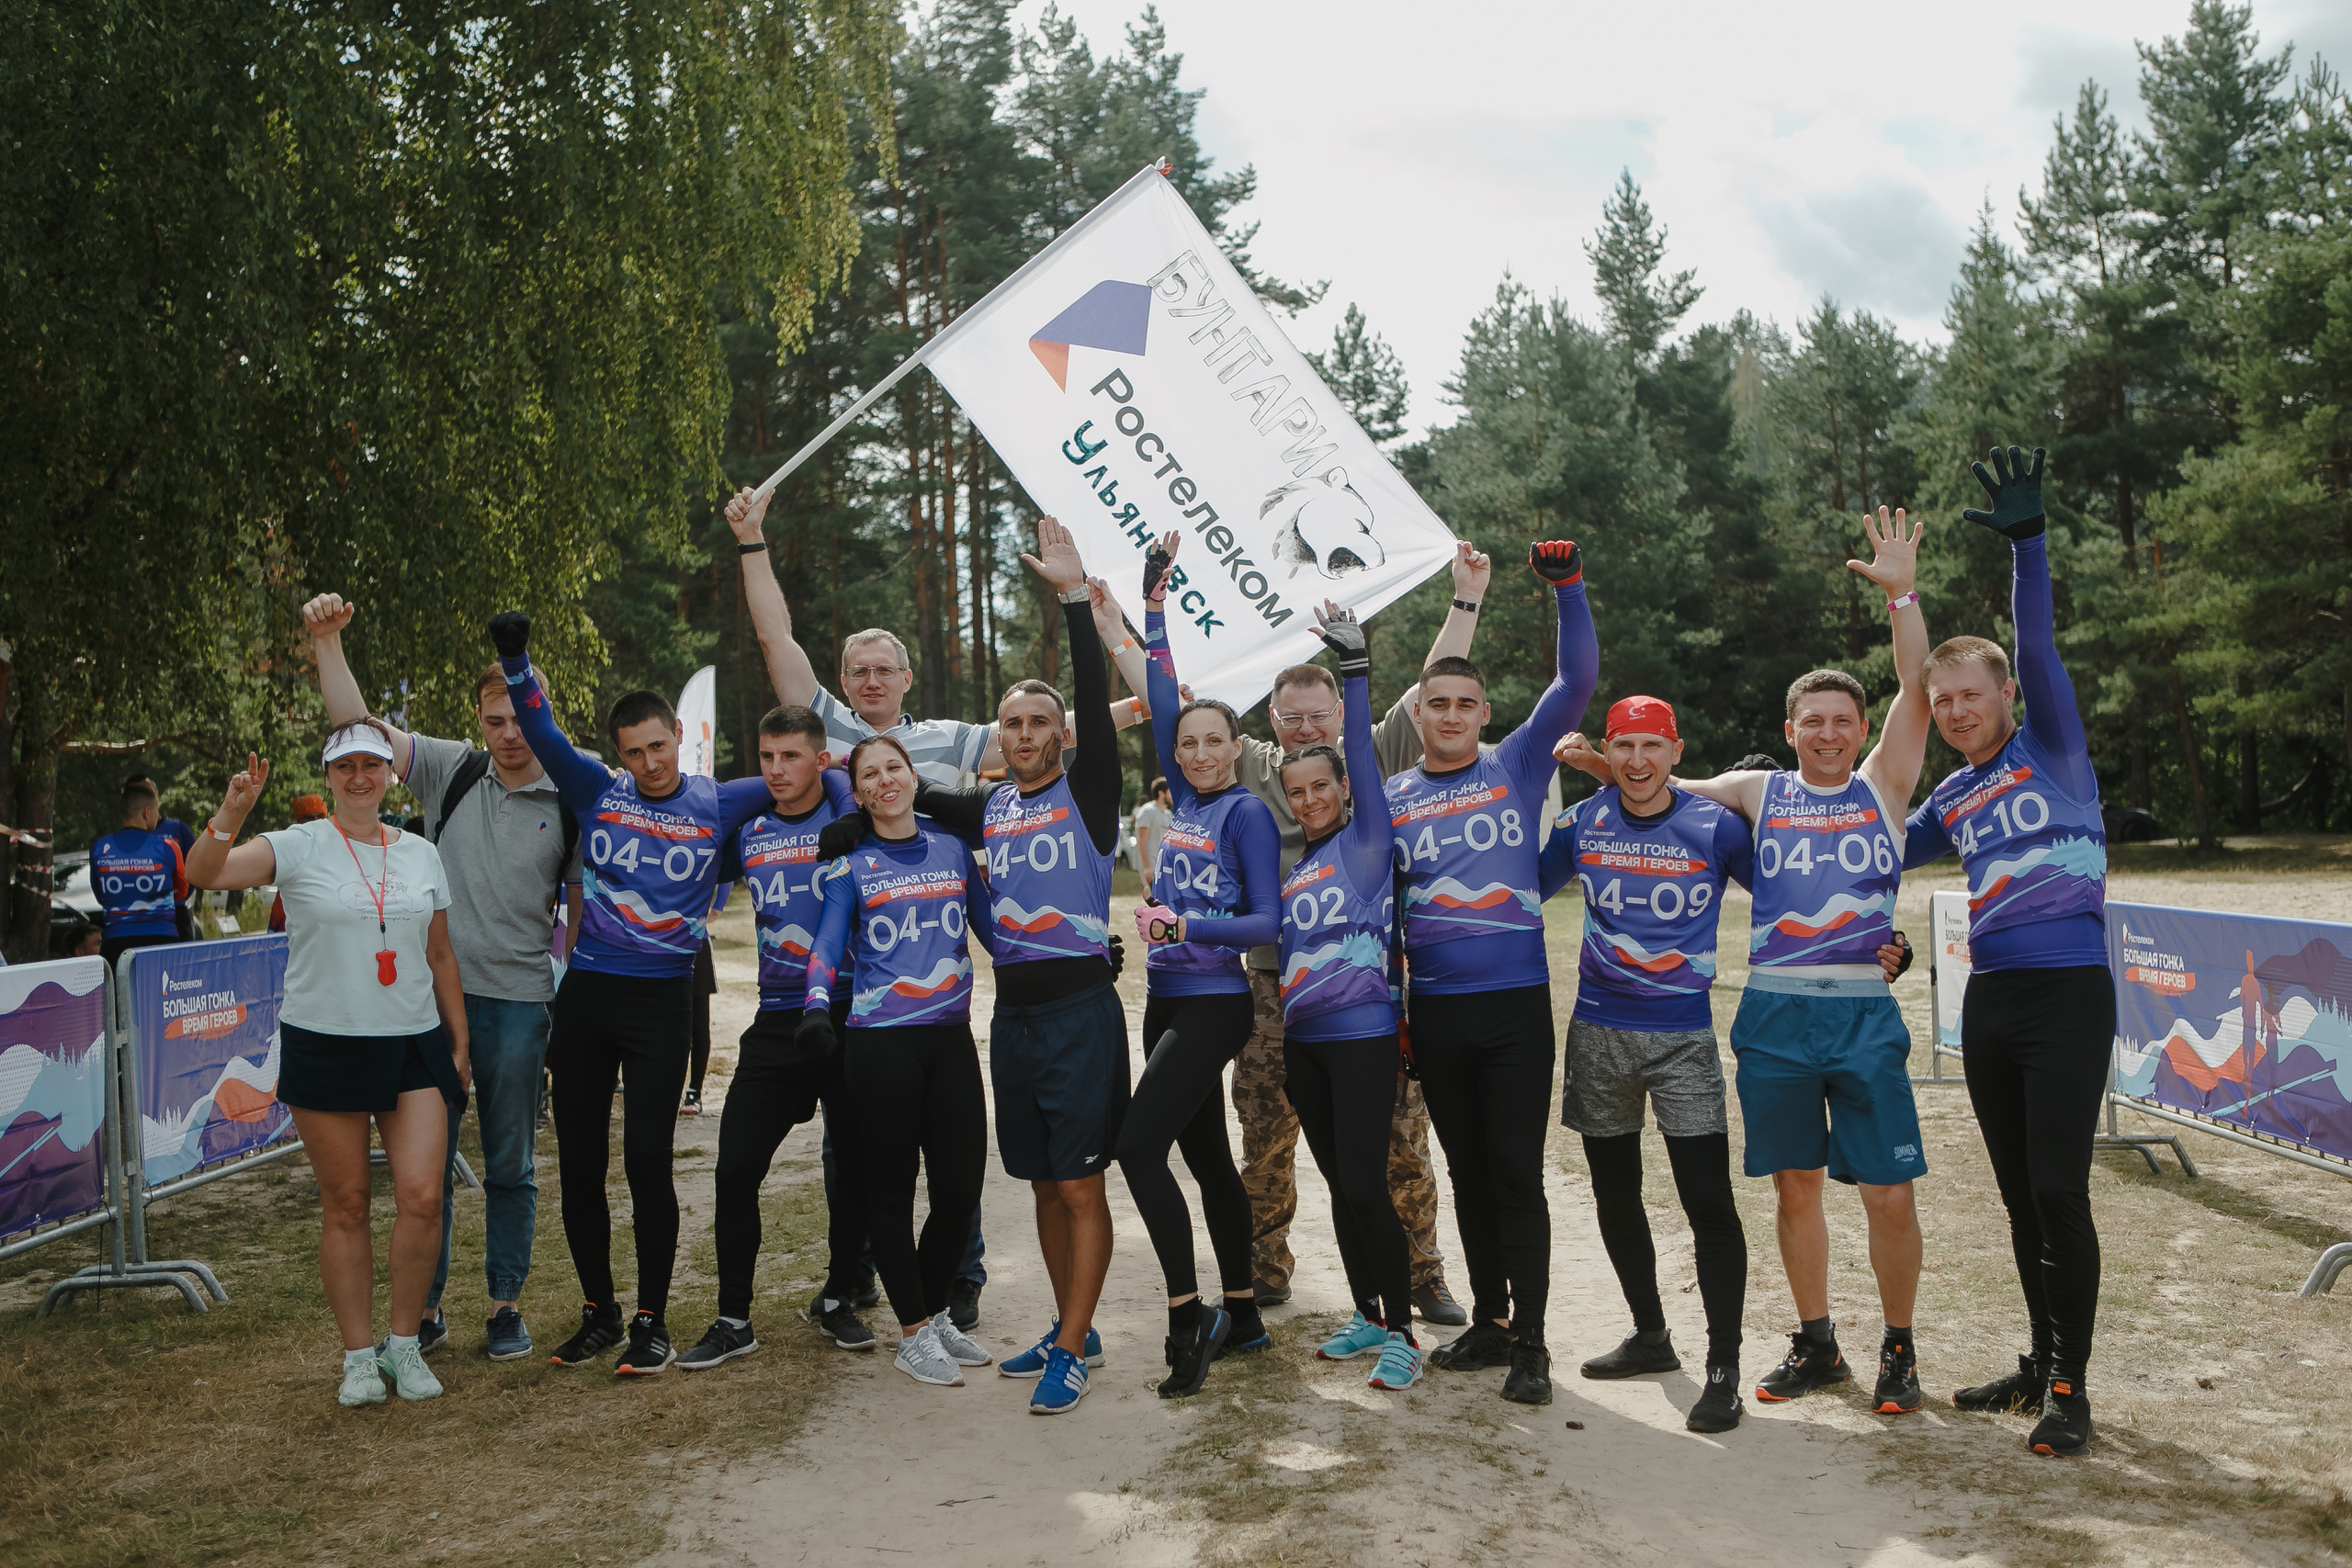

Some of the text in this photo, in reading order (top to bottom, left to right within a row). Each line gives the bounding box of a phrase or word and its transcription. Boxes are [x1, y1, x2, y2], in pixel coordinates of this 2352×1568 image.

[1146, 249, 1339, 478] БУНТАРИ
[1090, 367, 1295, 628] Ростелеком
[1409, 801, 1448, 820] ВРЕМЯ
[1957, 793, 1982, 817] ВРЕМЯ
[620, 814, 698, 837] ВРЕМЯ ГЕРОЕВ
[654, 812, 695, 826] ГОНКА
[591, 829, 717, 882] 04-07
[744, 836, 797, 856] БОЛЬШАЯ
[764, 845, 820, 863] ВРЕМЯ ГЕР
[1579, 840, 1689, 860] БОЛЬШАЯ ГОНКА
[1759, 833, 1894, 879] 04-06
[1600, 853, 1690, 872] ВРЕМЯ ГЕРОЕВ
[99, 874, 165, 894] 10-07
[748, 865, 831, 911] 04-0
[861, 869, 960, 897] БОЛЬШАЯ ГОНКА
[889, 880, 963, 899] ВРЕМЯ ГЕРОЕВ
[867, 900, 967, 952] 04-0
[2128, 931, 2154, 945] Ростелеком
[2123, 948, 2185, 972] БОЛЬШАЯ ГОНКА
[169, 978, 202, 992] Ростелеком
[2138, 967, 2187, 988] ВРЕМЯ ГЕРОЕВ
[163, 989, 236, 1019] БОЛЬШАЯ ГОНКА
[182, 1009, 239, 1034] ВРЕМЯ ГЕРОЕВ
